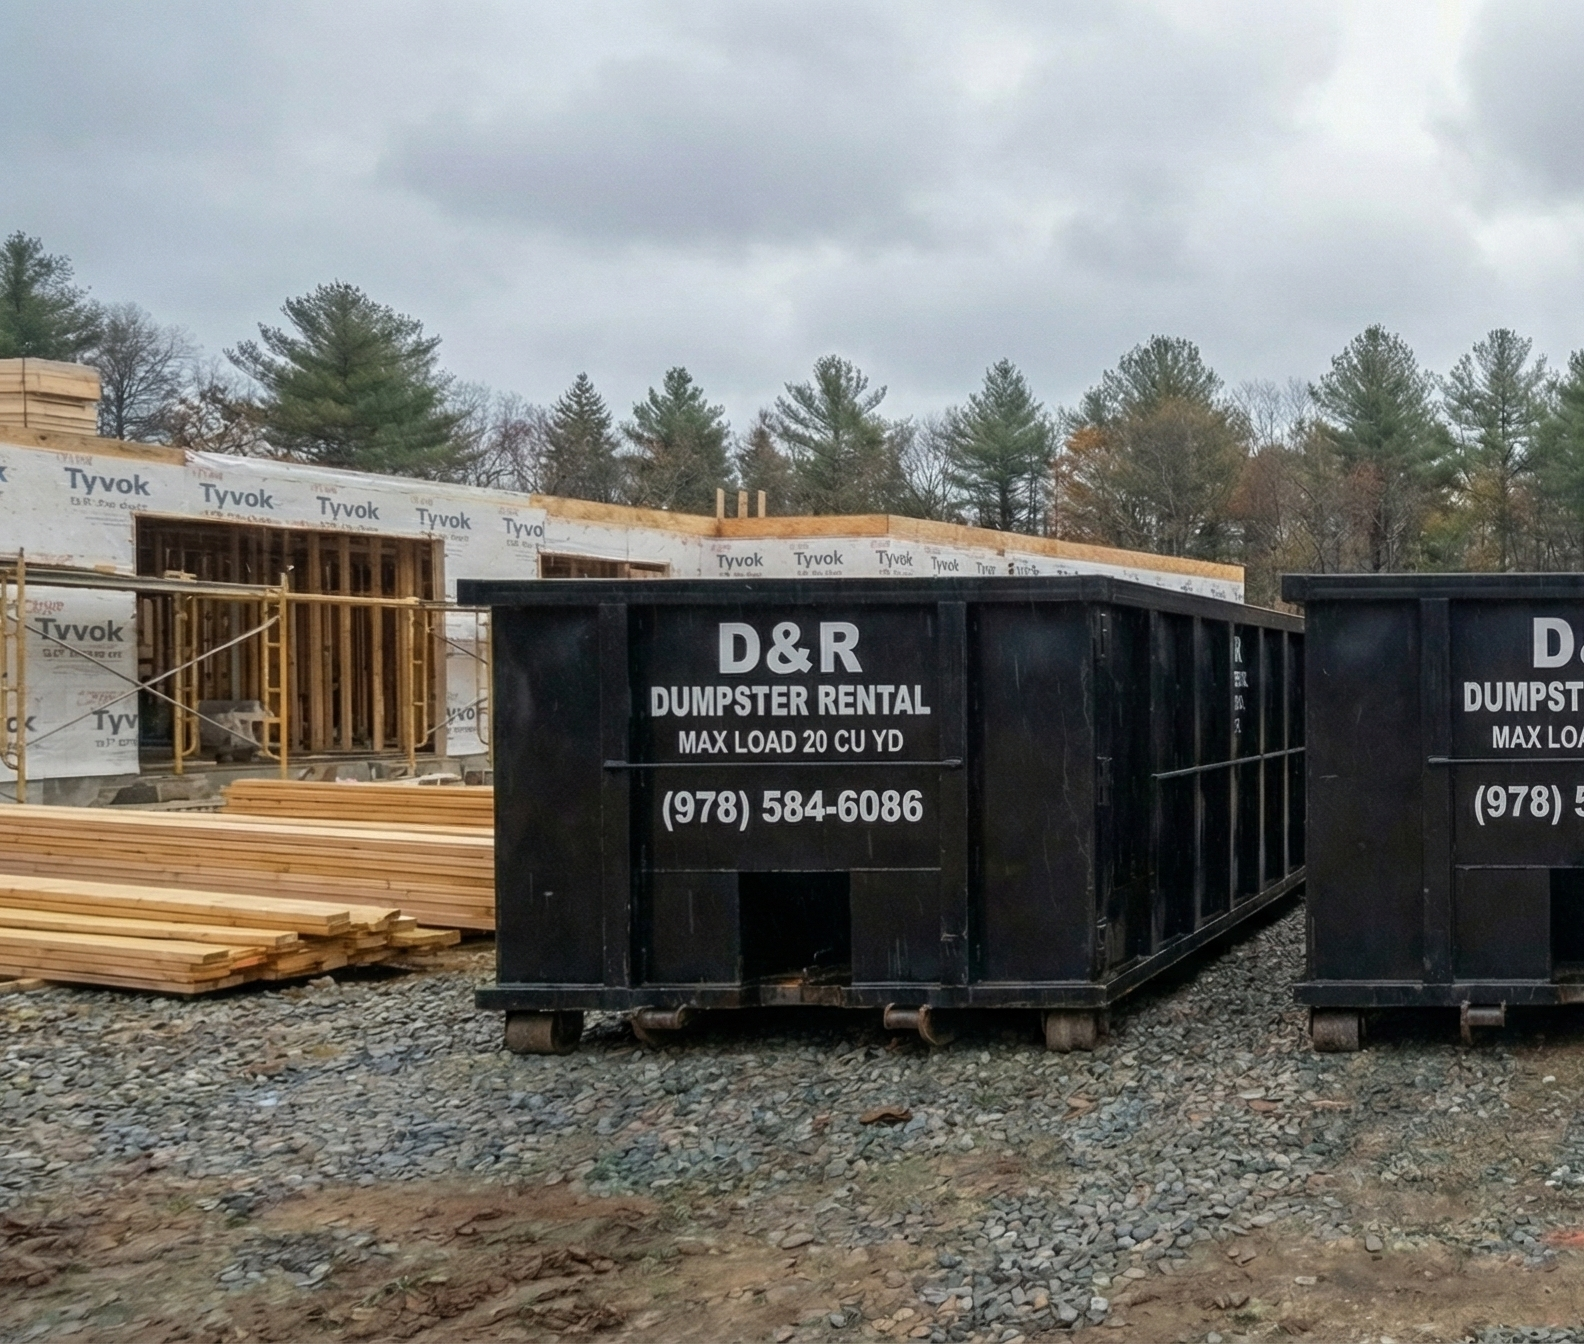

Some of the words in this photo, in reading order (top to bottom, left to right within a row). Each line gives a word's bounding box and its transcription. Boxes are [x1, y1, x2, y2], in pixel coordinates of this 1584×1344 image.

[64, 466, 151, 496] Tyvok
[199, 482, 274, 510] Tyvok
[316, 496, 380, 520] Tyvok
[415, 507, 472, 530] Tyvok
[502, 517, 546, 539] Tyvo
[716, 552, 764, 569] Tyvok
[793, 550, 844, 568] Tyvok
[718, 621, 863, 674] D&R
[651, 685, 809, 717] DUMPSTER
[818, 685, 931, 715] RENTAL
[678, 730, 728, 754] MAX
[735, 730, 797, 753] LOAD
[803, 730, 828, 753] 20
[834, 729, 865, 753] CU
[872, 729, 904, 752] YD
[1492, 725, 1542, 749] MAX
[662, 790, 750, 832] (978)
[762, 789, 924, 823] 584-6086
[1474, 784, 1562, 826] (978)
